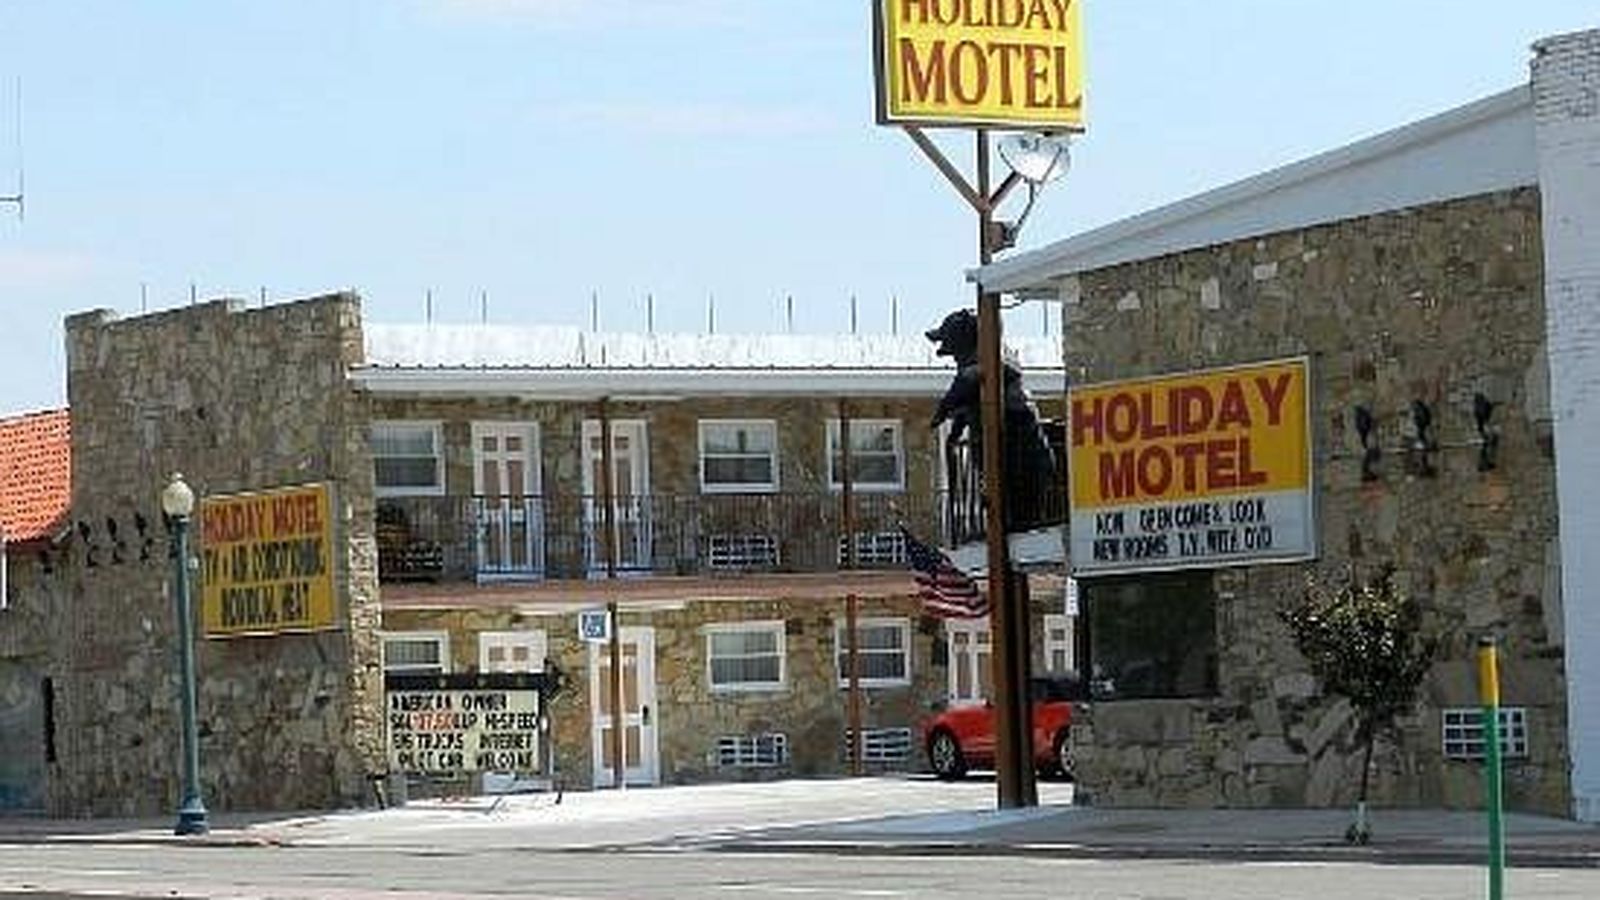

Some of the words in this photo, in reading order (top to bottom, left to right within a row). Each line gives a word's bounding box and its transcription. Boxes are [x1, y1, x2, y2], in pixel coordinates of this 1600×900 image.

[900, 0, 1070, 31] HOLIDAY
[900, 38, 1081, 108] MOTEL
[1072, 373, 1291, 446] HOLIDAY
[1100, 437, 1267, 499] MOTEL
[273, 494, 322, 536] MOTEL
